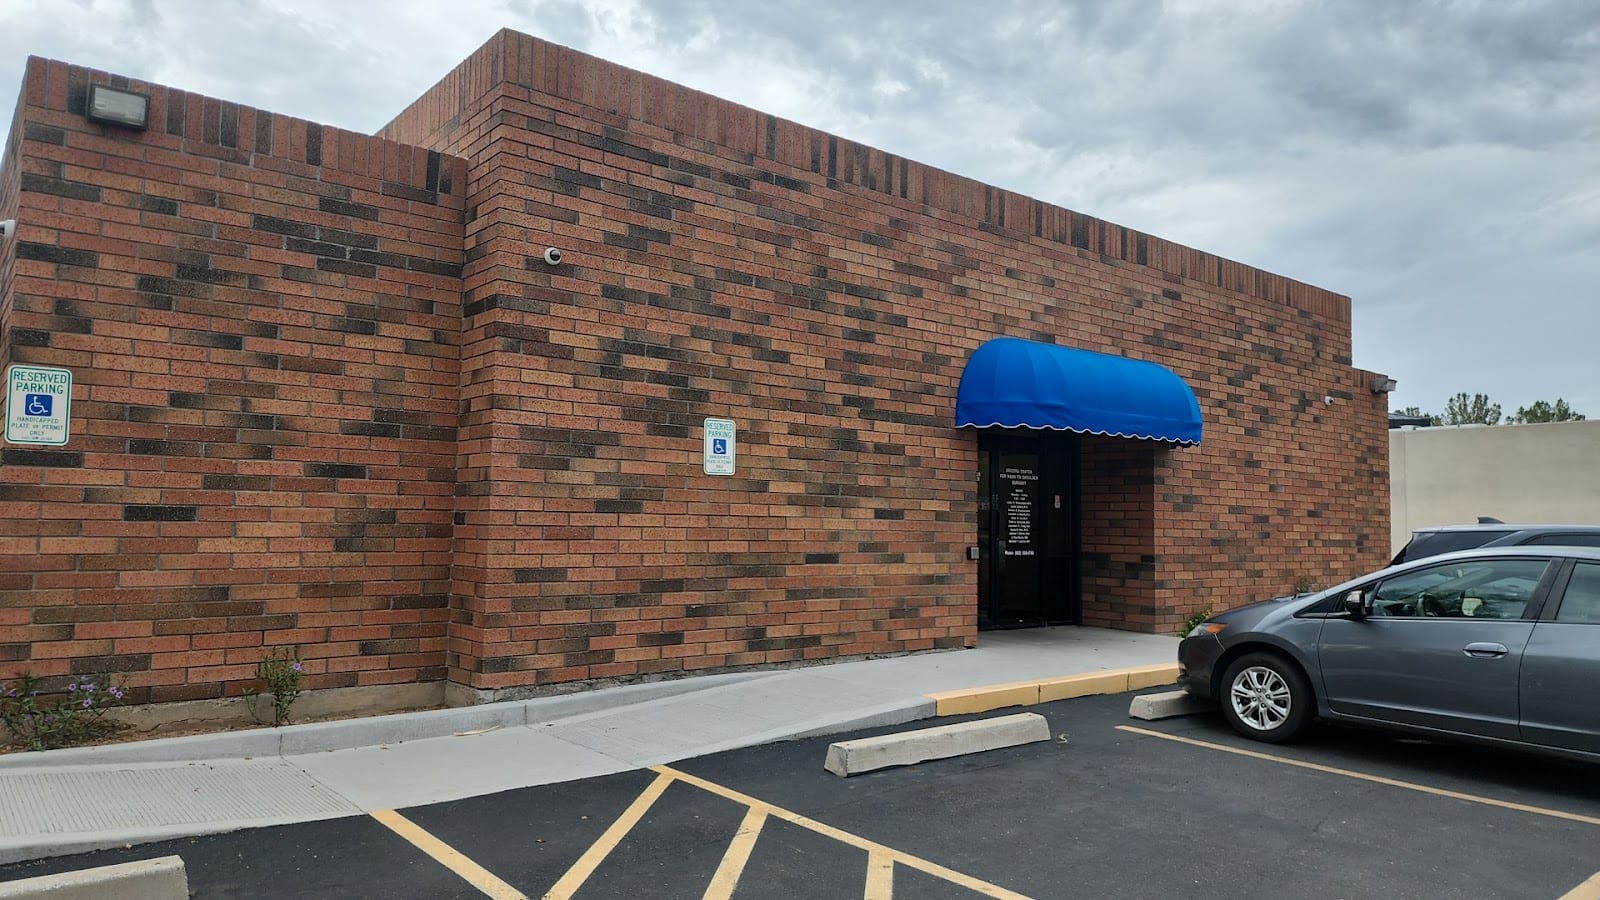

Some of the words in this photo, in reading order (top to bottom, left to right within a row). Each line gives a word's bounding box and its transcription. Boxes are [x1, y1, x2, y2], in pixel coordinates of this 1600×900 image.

[13, 371, 67, 384] RESERVED
[16, 382, 63, 394] PARKING
[17, 416, 59, 424] HANDICAPPED
[707, 422, 732, 431] RESERVED
[708, 430, 732, 439] PARKING
